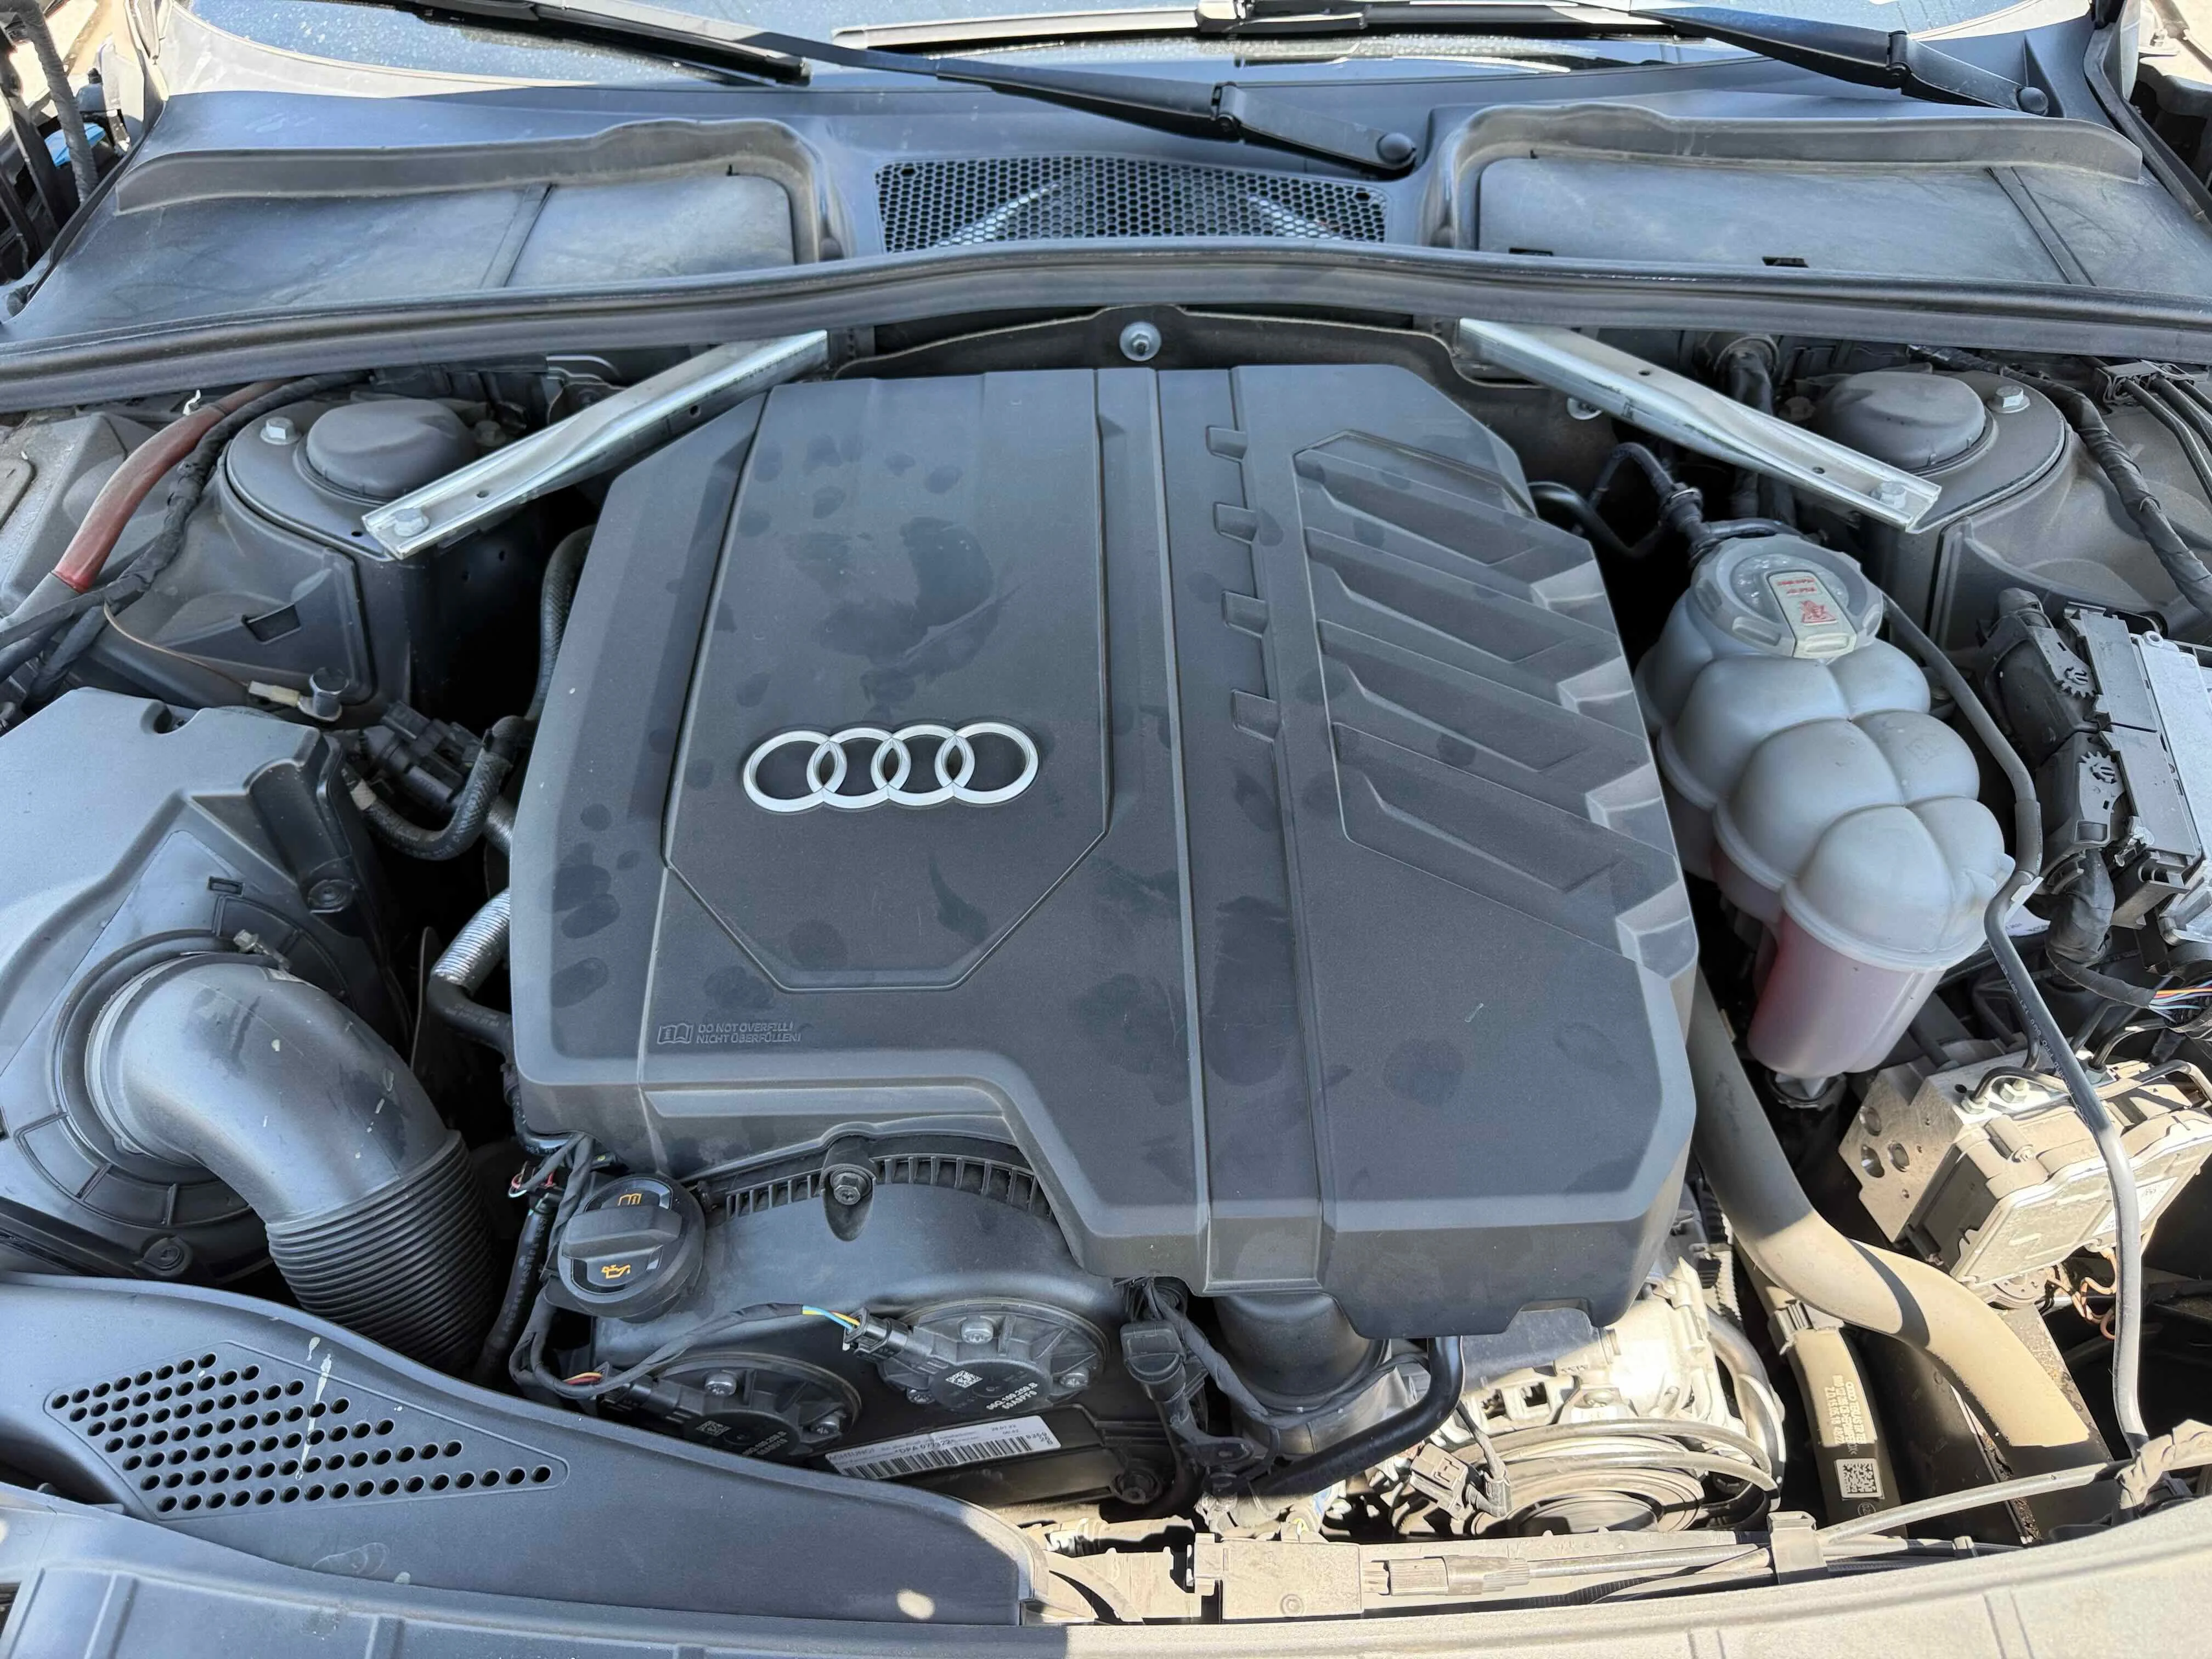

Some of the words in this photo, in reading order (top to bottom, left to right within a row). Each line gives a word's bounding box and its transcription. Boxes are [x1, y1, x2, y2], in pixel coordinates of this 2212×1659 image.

[698, 1024, 713, 1032] DO
[715, 1023, 739, 1032] NOT
[740, 1022, 793, 1032] OVERFILL!
[696, 1034, 727, 1043] NICHT
